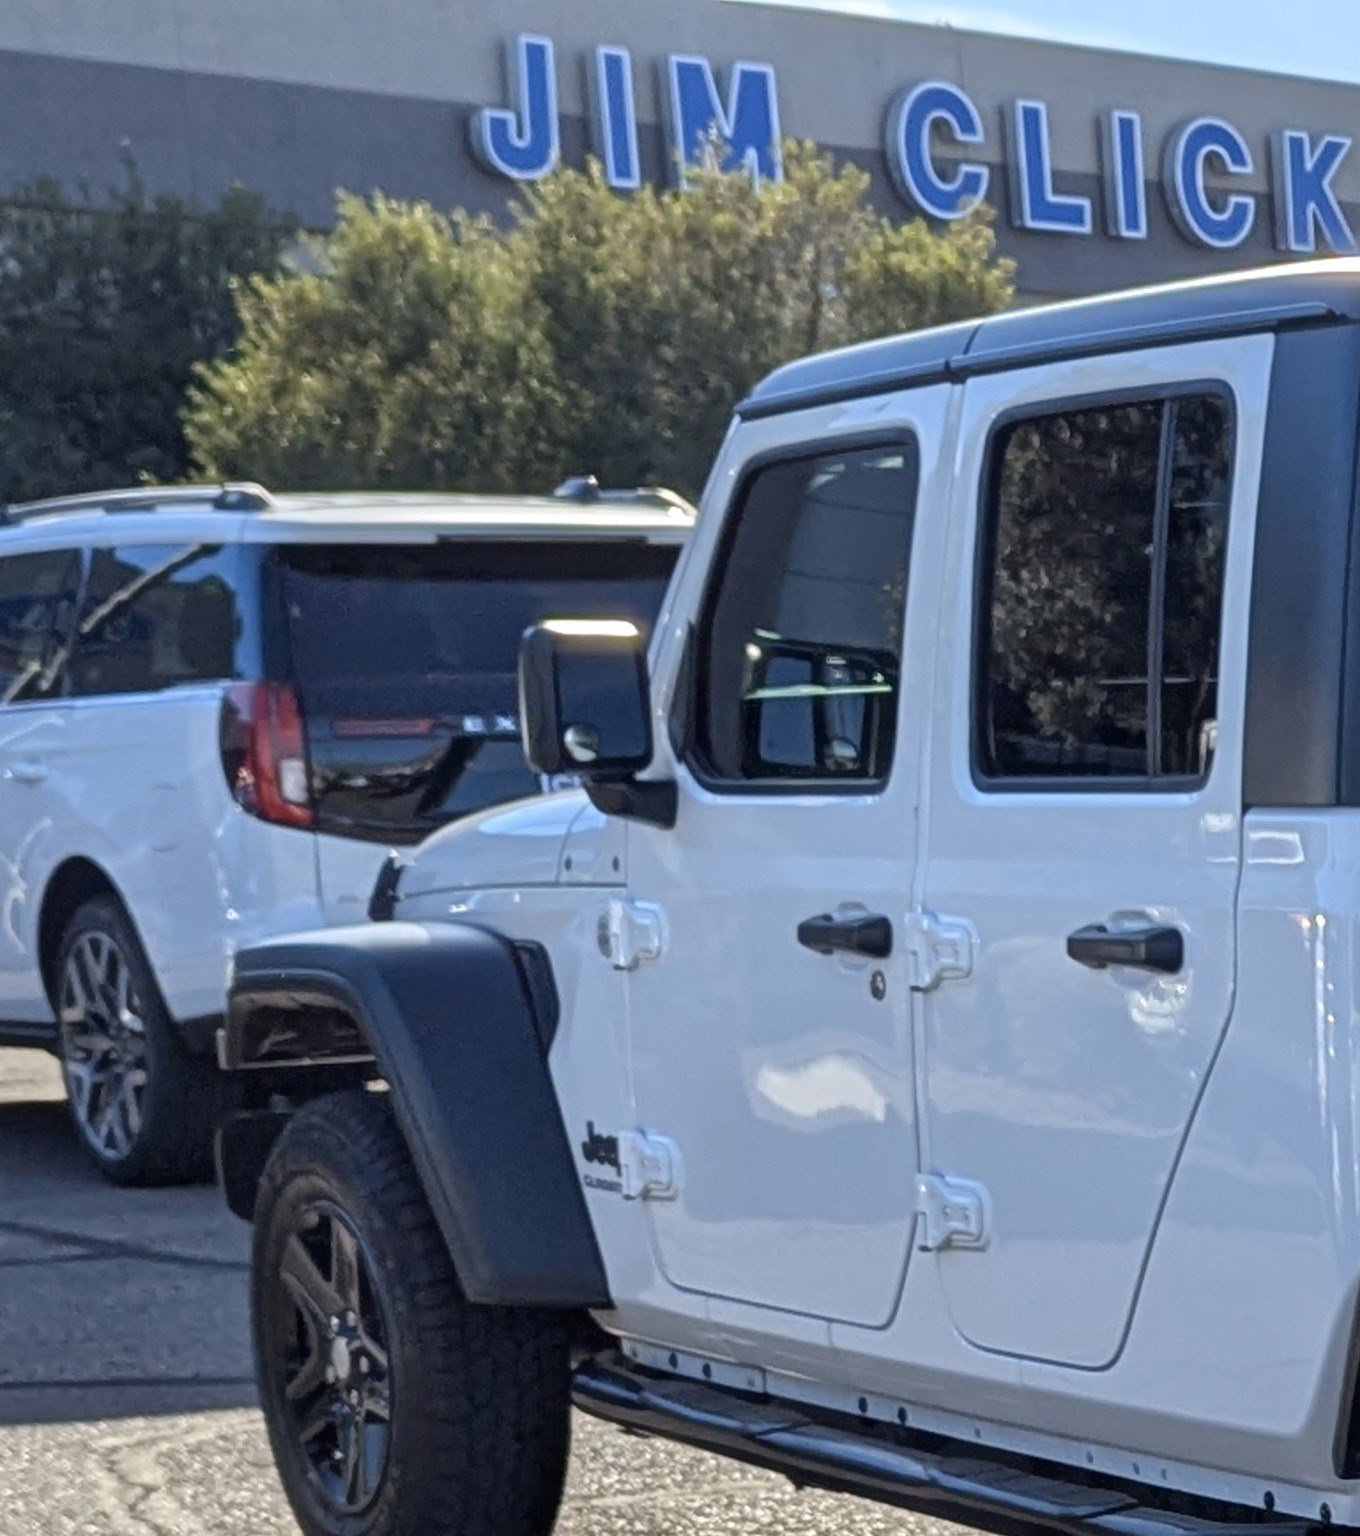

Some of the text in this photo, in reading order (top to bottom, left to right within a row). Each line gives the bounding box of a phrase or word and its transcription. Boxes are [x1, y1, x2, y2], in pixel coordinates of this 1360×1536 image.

[474, 33, 1359, 254] JIM CLICK
[581, 1120, 622, 1177] Jeep
